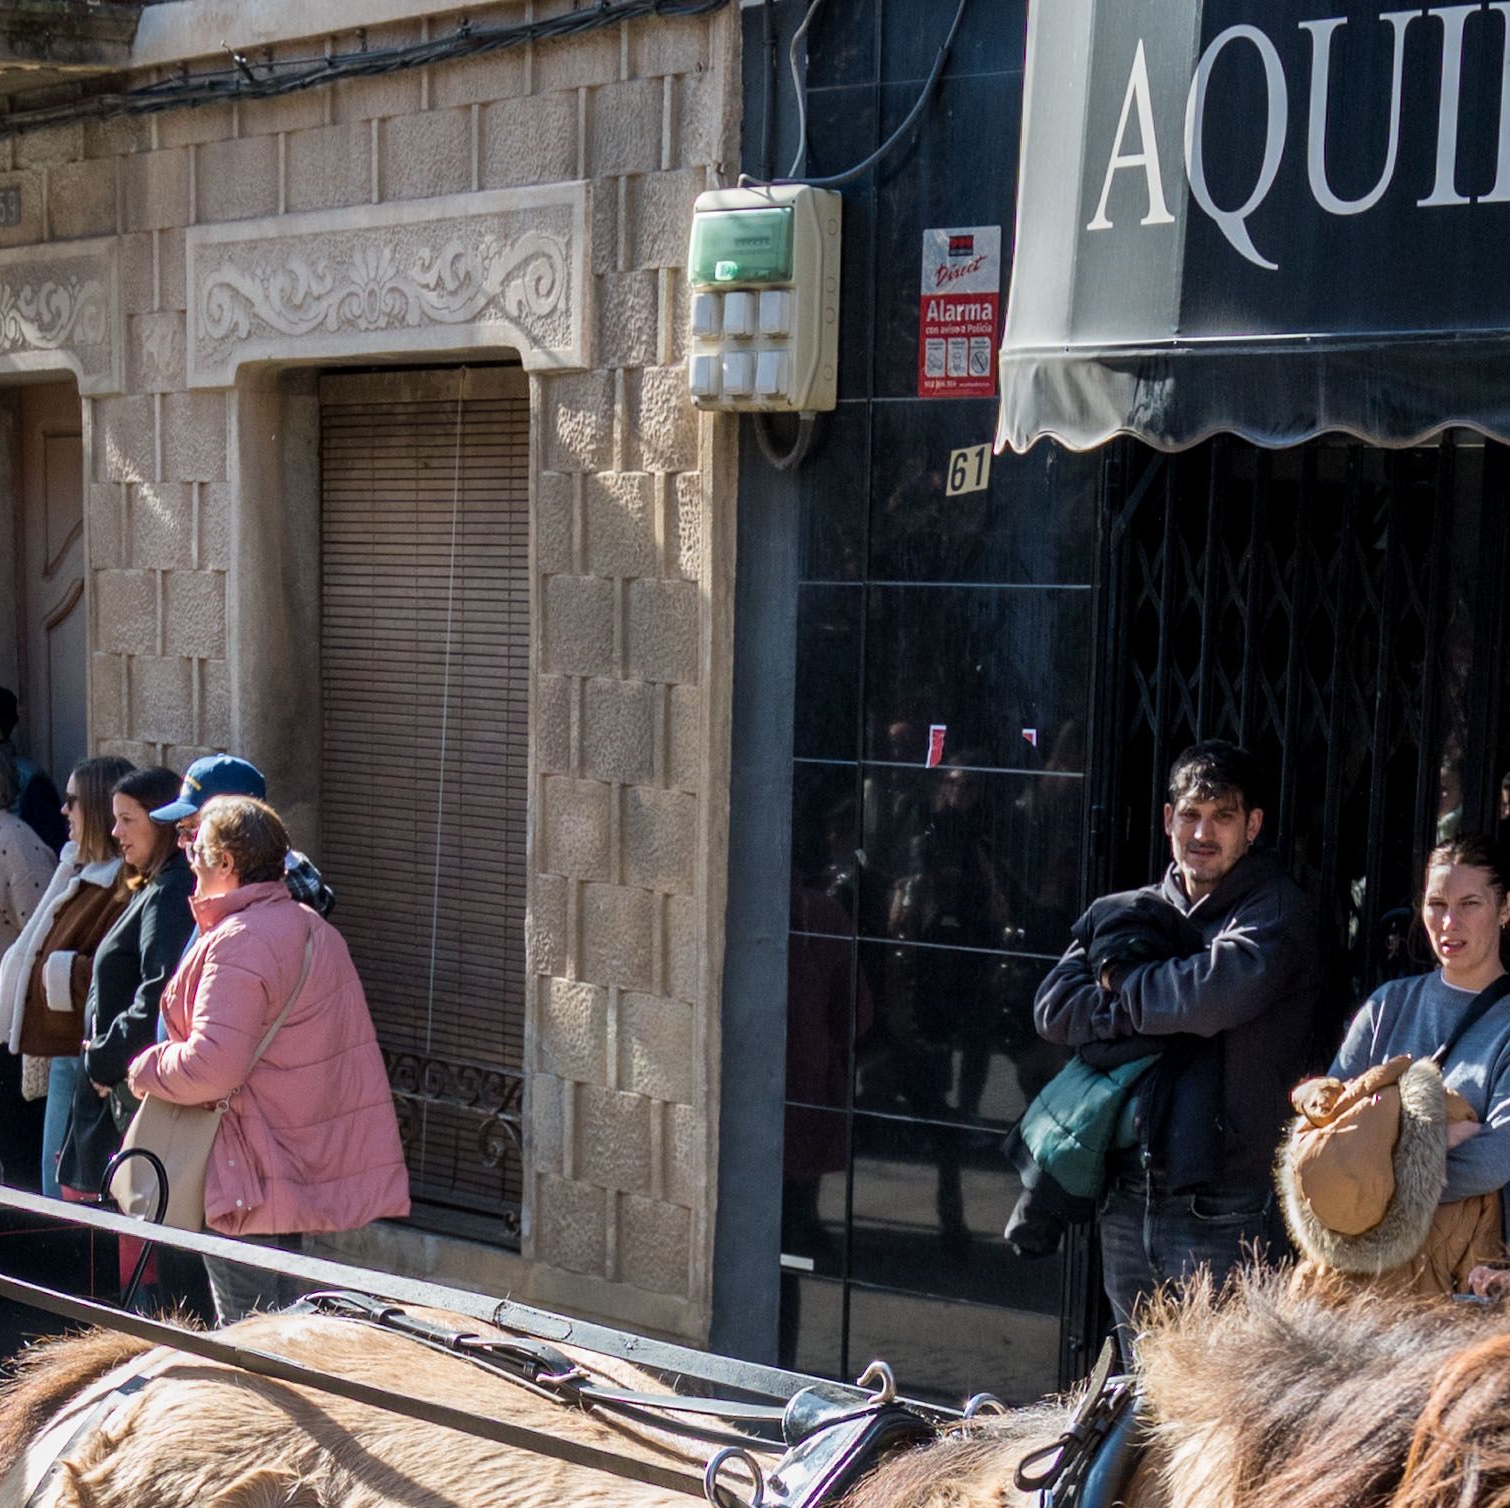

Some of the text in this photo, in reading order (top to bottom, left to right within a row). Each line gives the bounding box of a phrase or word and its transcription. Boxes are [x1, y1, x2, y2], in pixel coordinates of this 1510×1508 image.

[935, 255, 987, 288] Direct
[926, 299, 993, 322] Alarma
[951, 446, 985, 491] 61
